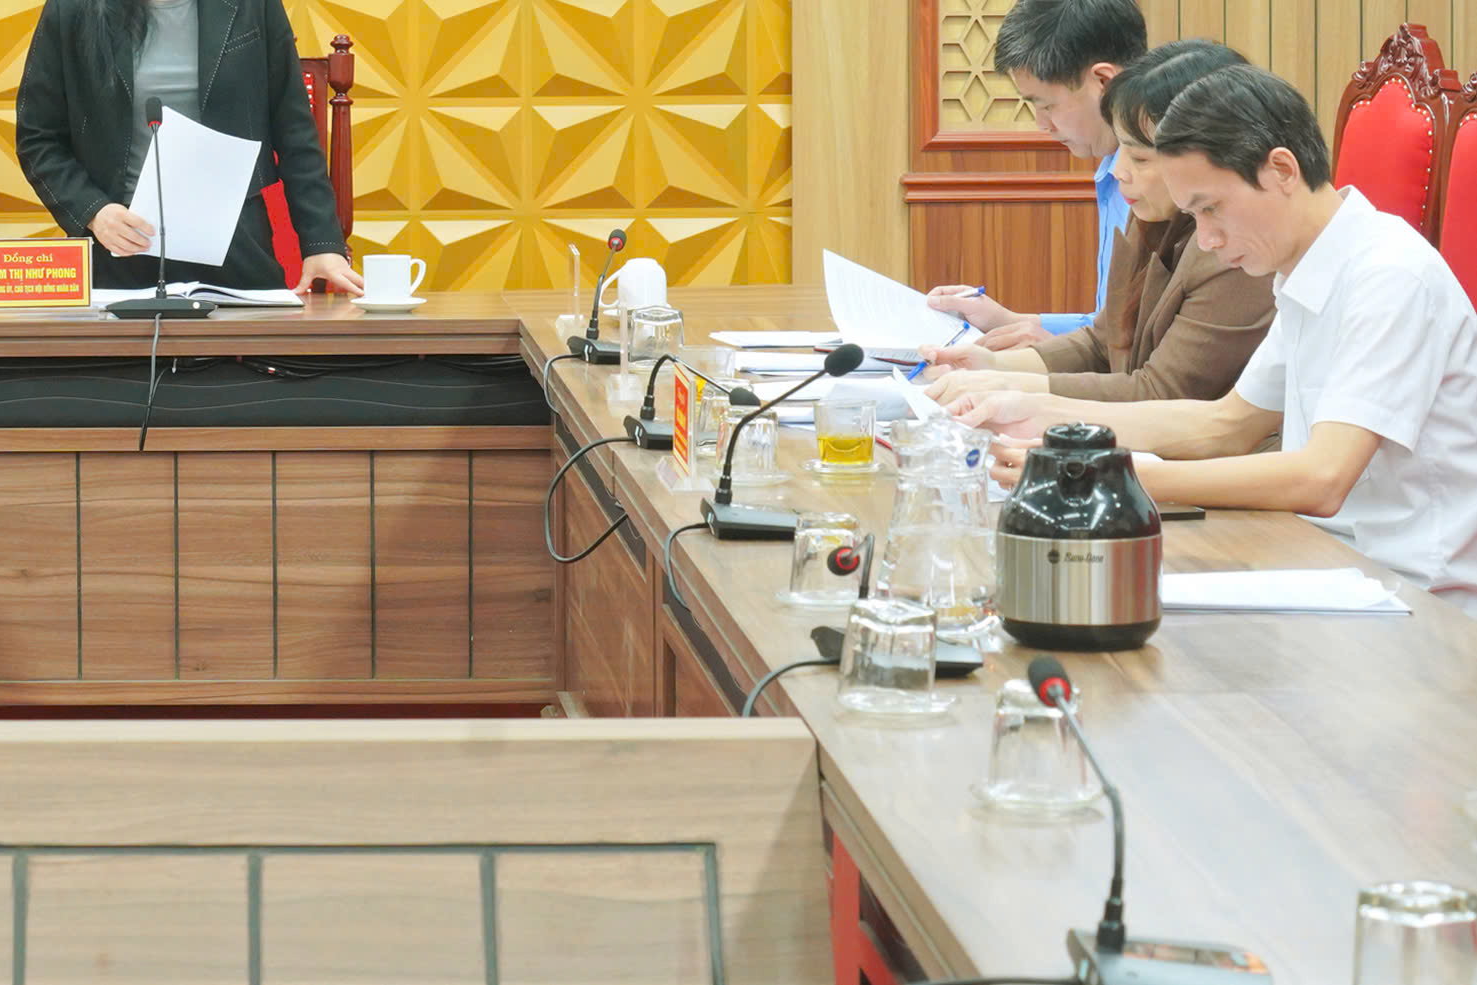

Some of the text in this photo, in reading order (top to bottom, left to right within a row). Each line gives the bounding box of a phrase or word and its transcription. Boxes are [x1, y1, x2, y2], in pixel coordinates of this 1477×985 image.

[36, 252, 53, 263] chí
[9, 269, 24, 281] THỊ
[25, 267, 45, 279] NHƯ
[46, 268, 77, 279] PHONG
